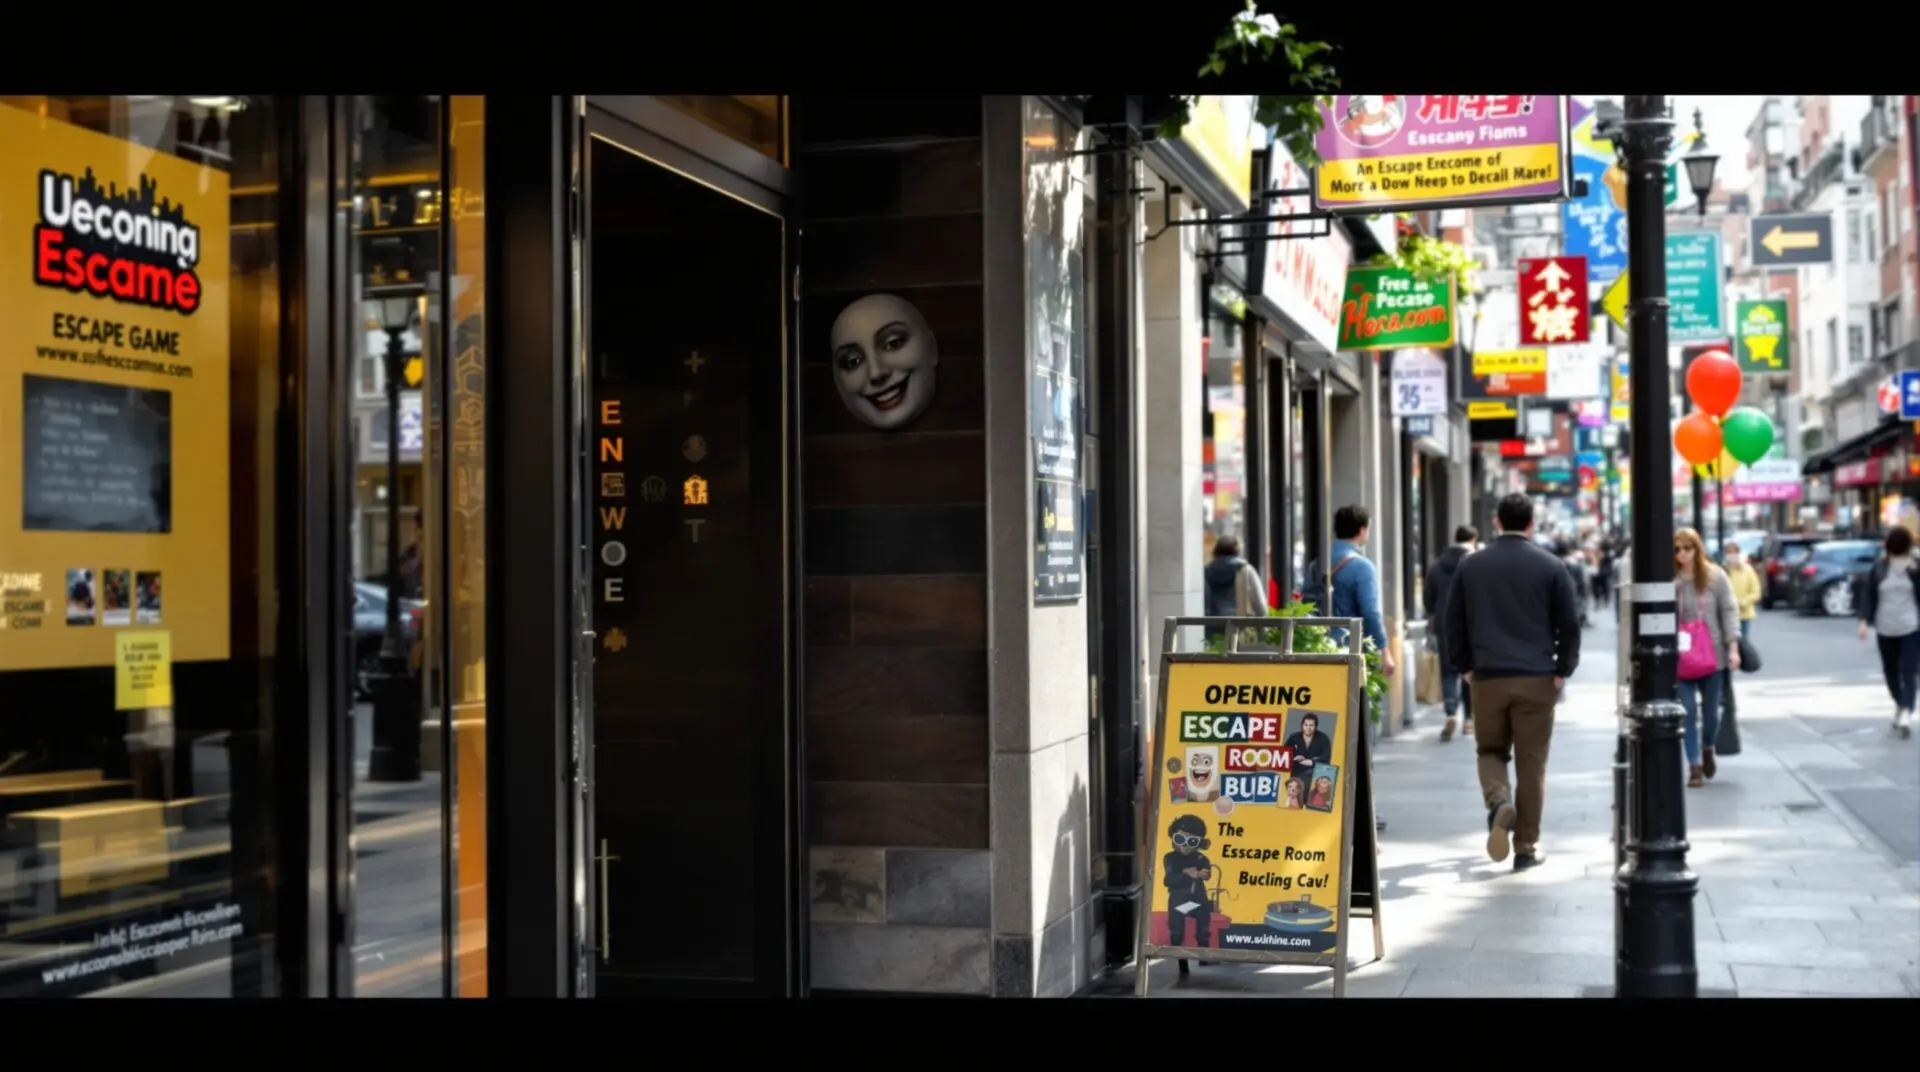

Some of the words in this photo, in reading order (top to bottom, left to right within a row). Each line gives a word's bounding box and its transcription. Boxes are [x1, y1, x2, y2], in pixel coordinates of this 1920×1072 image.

[1357, 162, 1373, 175] An
[1378, 160, 1422, 174] Escape
[1487, 152, 1501, 166] of
[1451, 173, 1465, 186] to
[38, 228, 199, 309] Escame
[1379, 275, 1410, 291] Free
[53, 312, 124, 347] ESCAPE
[129, 325, 180, 356] GAME
[1205, 685, 1312, 705] OPENING
[1184, 715, 1277, 739] ESCAPE
[1229, 748, 1290, 769] ROOM
[1225, 775, 1280, 798] BUB!
[1218, 822, 1244, 837] The
[1222, 844, 1280, 863] Esscape
[1284, 846, 1326, 861] Room
[1238, 871, 1292, 890] Bucling
[1297, 873, 1329, 888] Cav!
